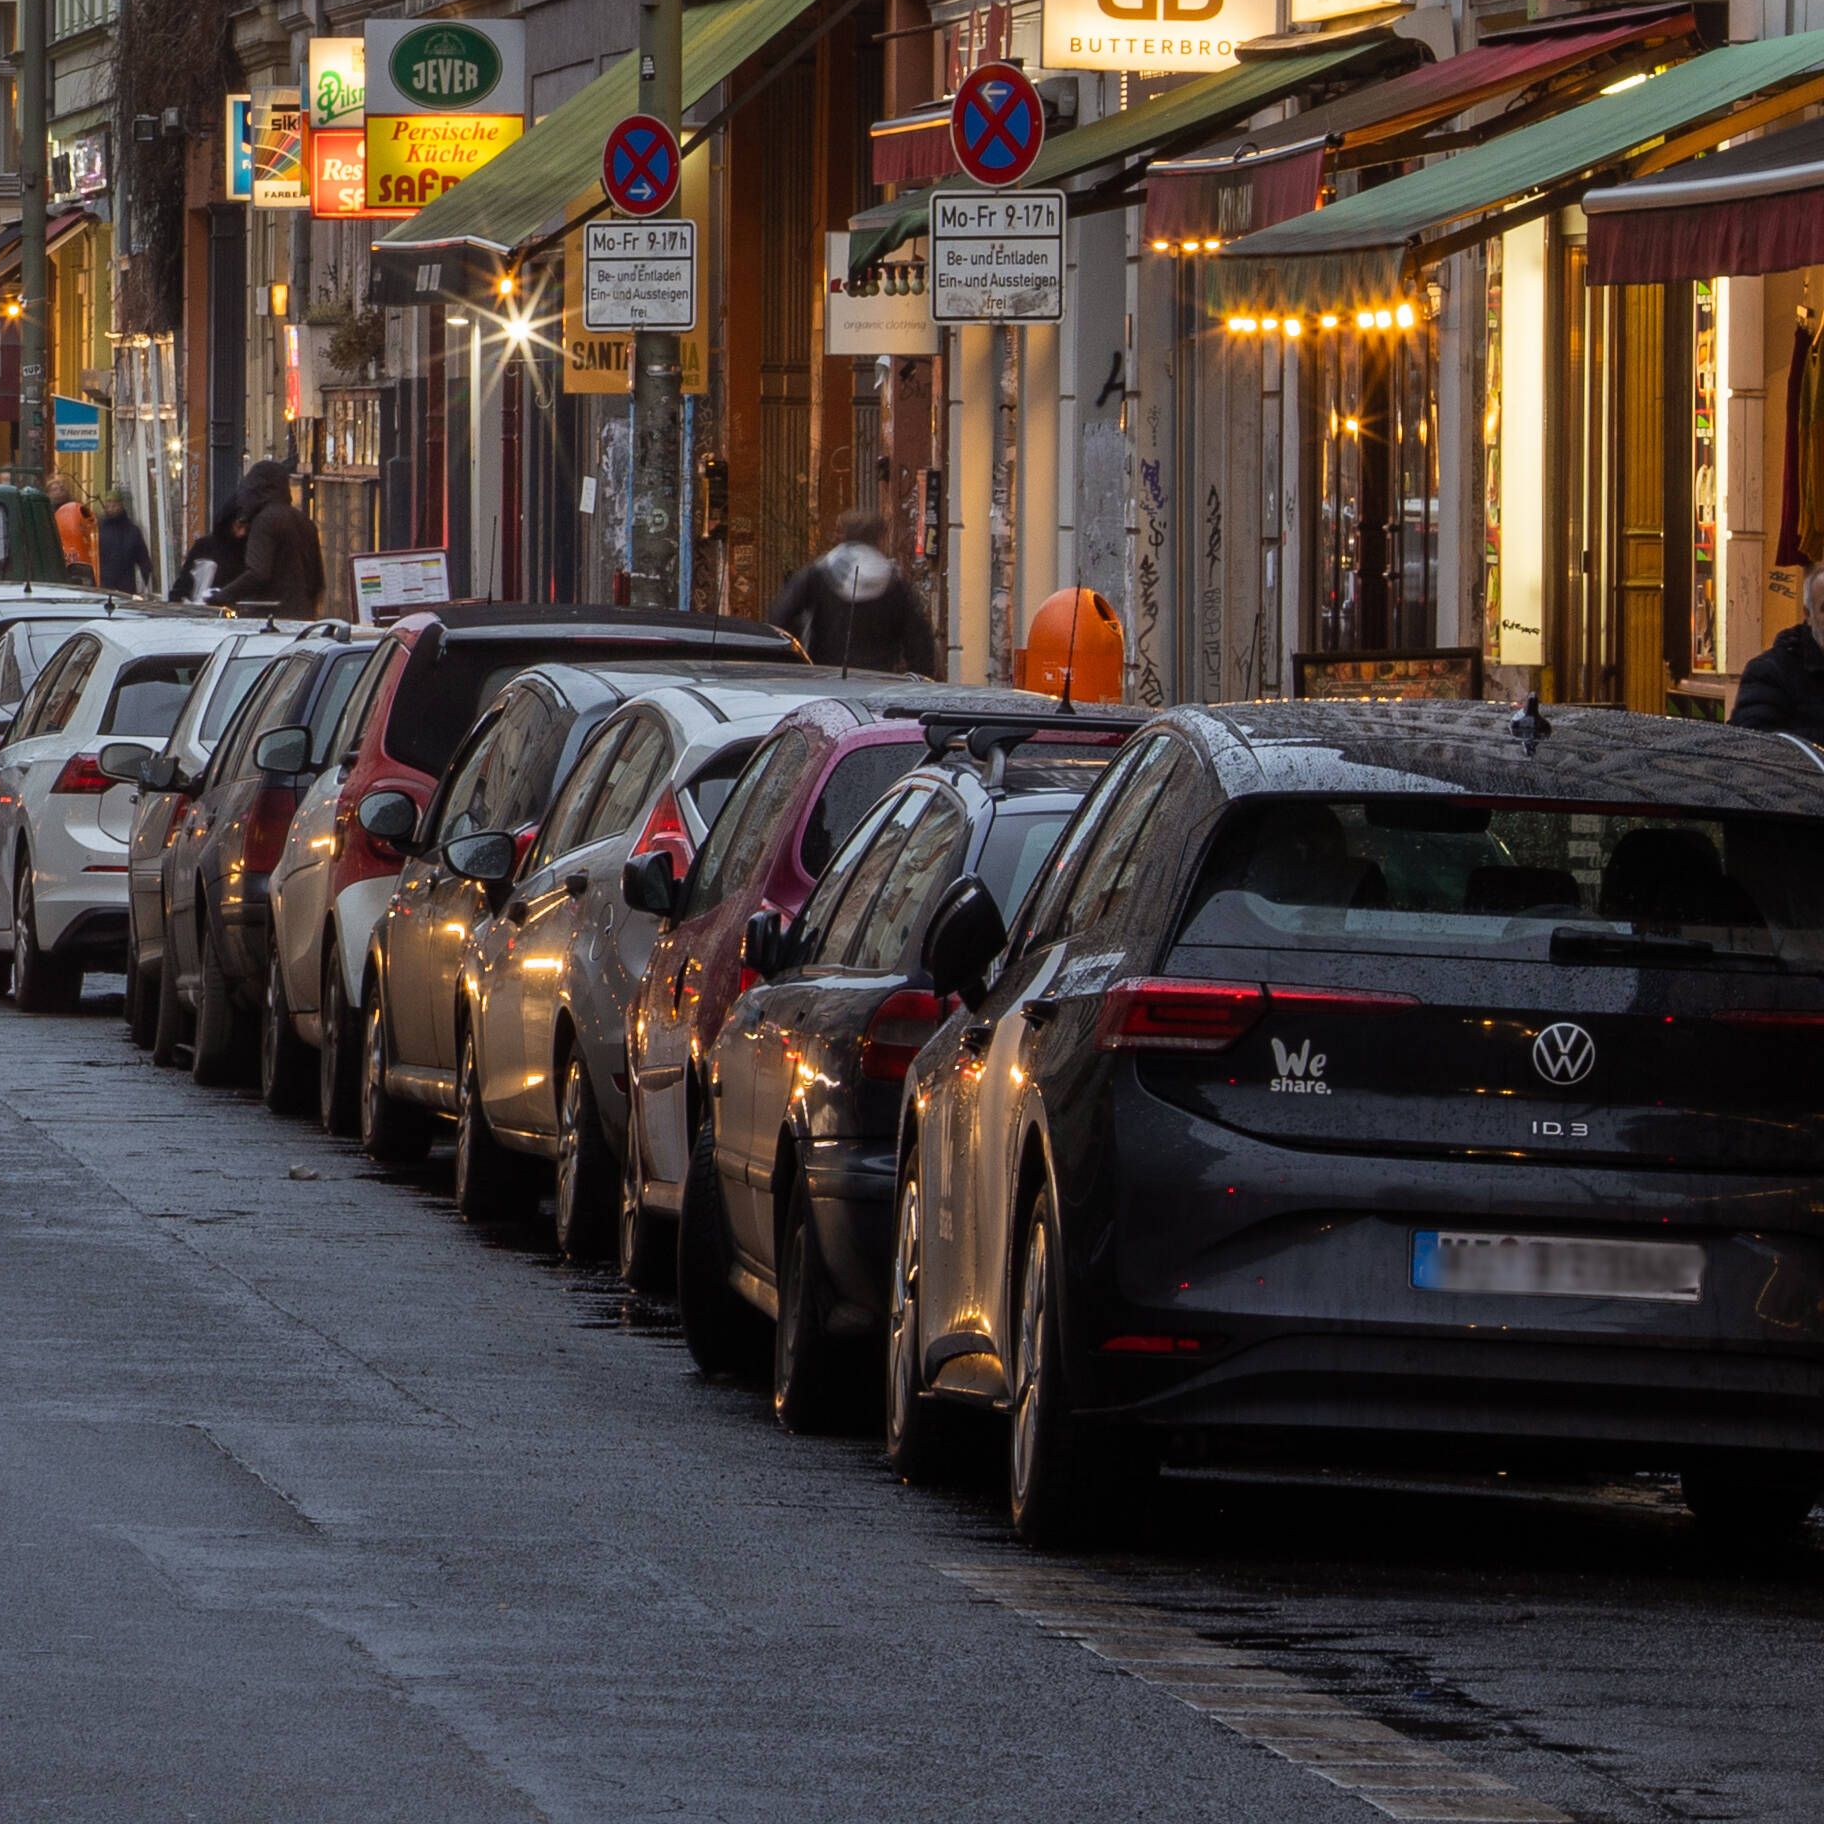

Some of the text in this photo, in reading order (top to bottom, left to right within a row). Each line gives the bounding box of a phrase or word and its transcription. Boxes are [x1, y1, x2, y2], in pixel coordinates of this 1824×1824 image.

[413, 58, 478, 95] JEVER
[271, 117, 300, 131] sik
[392, 121, 499, 141] Persische
[405, 144, 478, 163] Küche
[322, 159, 364, 181] Res
[941, 205, 996, 228] Mo-Fr
[593, 233, 639, 251] Mo-Fr
[971, 250, 993, 265] und
[996, 250, 1048, 265] Entladen
[617, 270, 636, 282] und
[638, 270, 681, 282] Entladen
[965, 274, 988, 288] und
[990, 273, 1057, 290] Aussteigen
[613, 289, 632, 301] und
[633, 289, 688, 302] Aussteigen
[986, 296, 1006, 309] frei
[631, 306, 647, 318] frei
[1271, 1038, 1327, 1077] We
[1270, 1076, 1332, 1095] share.
